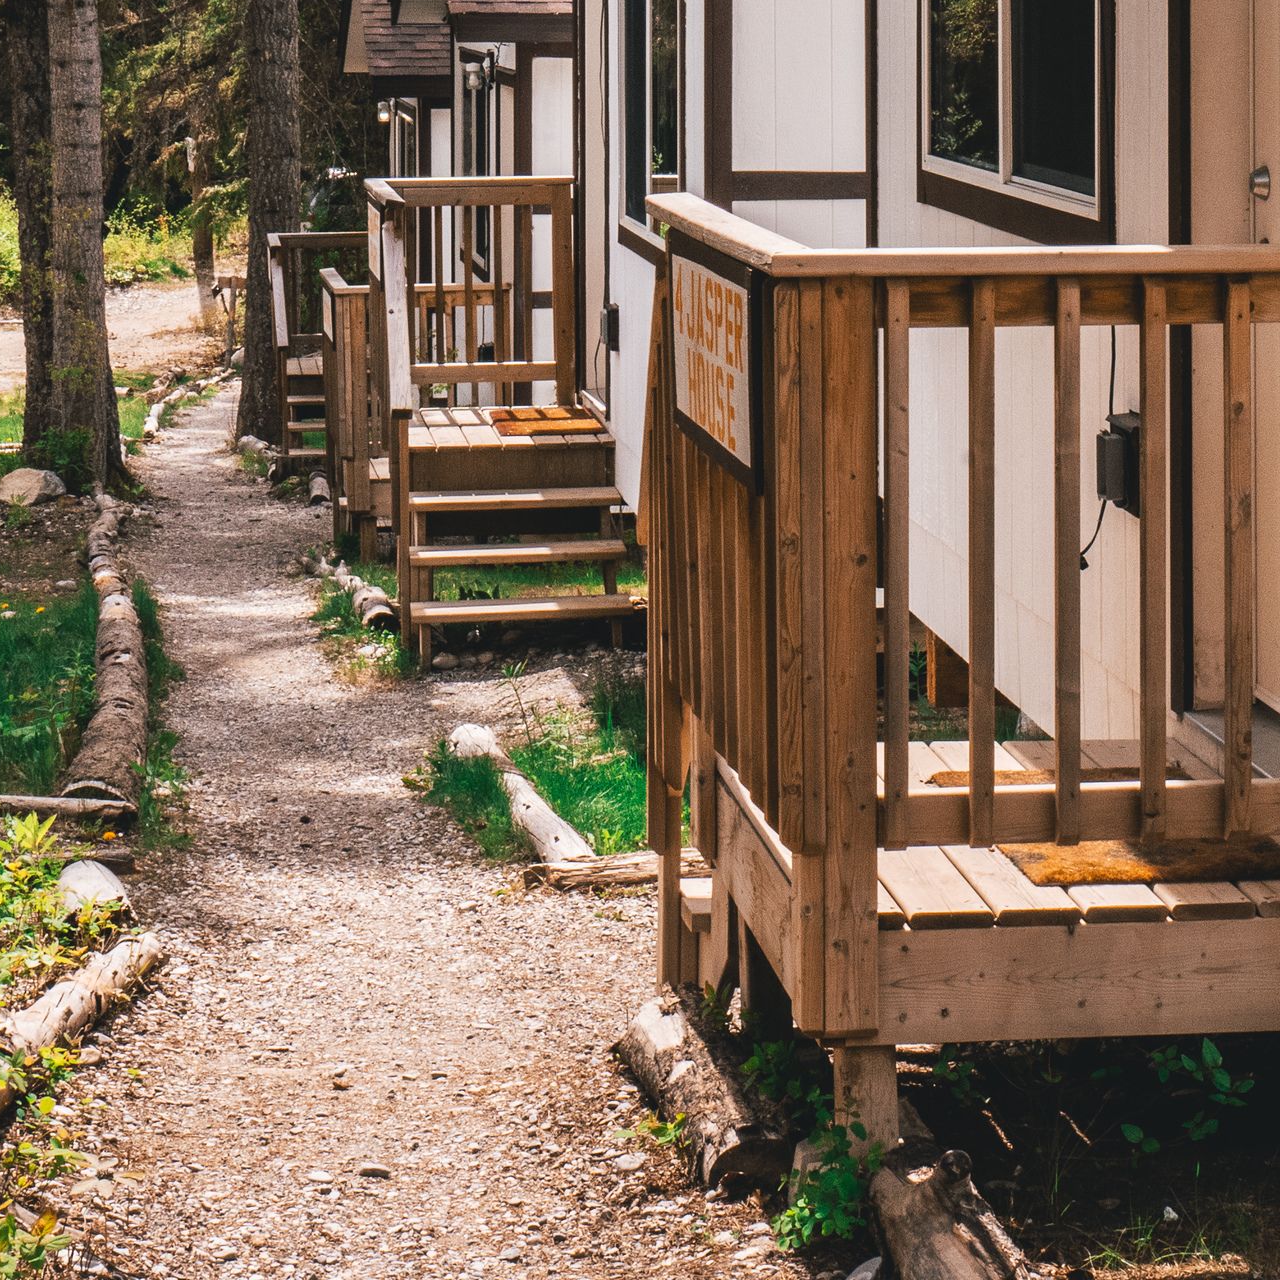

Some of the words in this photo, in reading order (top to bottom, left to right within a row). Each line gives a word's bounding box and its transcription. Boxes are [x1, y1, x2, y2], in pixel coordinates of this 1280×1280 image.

[675, 263, 683, 335] 4
[686, 269, 744, 374] JASPER
[687, 347, 737, 452] HOUSE
